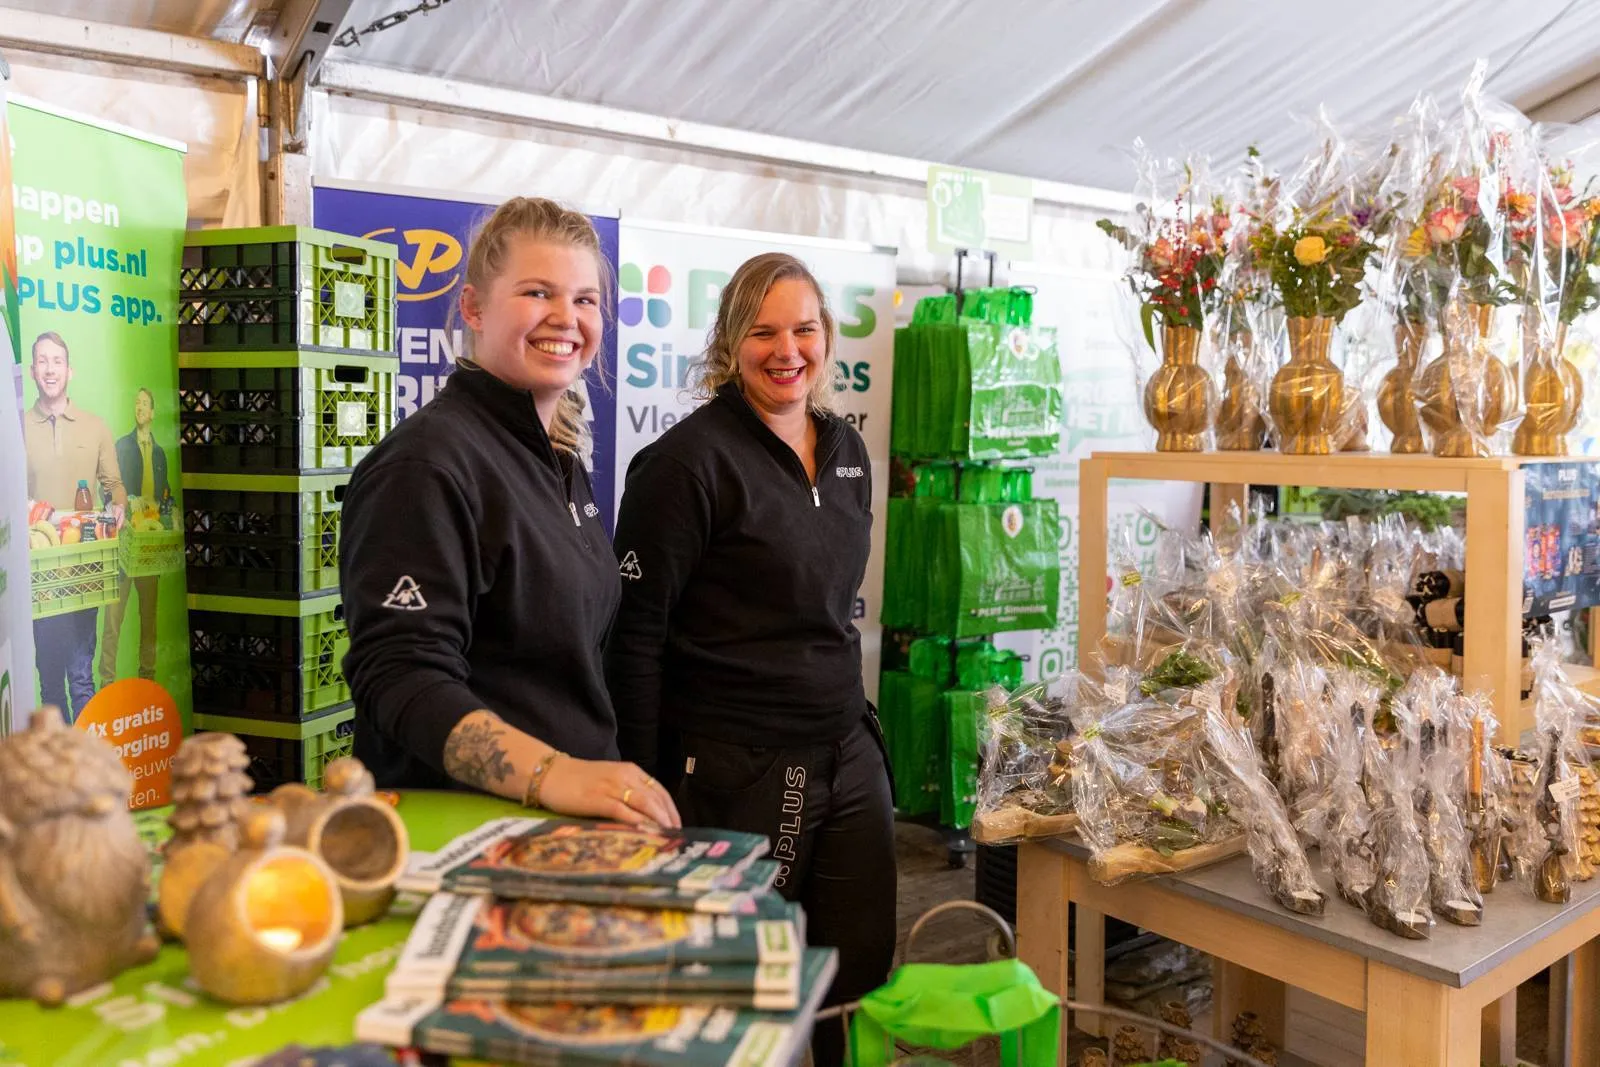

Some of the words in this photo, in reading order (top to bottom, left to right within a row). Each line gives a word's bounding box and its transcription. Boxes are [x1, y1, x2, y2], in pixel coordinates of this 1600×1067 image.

[54, 236, 147, 277] plus.nl
[17, 276, 101, 314] PLUS
[110, 294, 163, 326] app.
[112, 705, 164, 736] gratis
[113, 731, 170, 760] orging
[128, 788, 160, 809] ten.
[773, 766, 806, 861] PLUS
